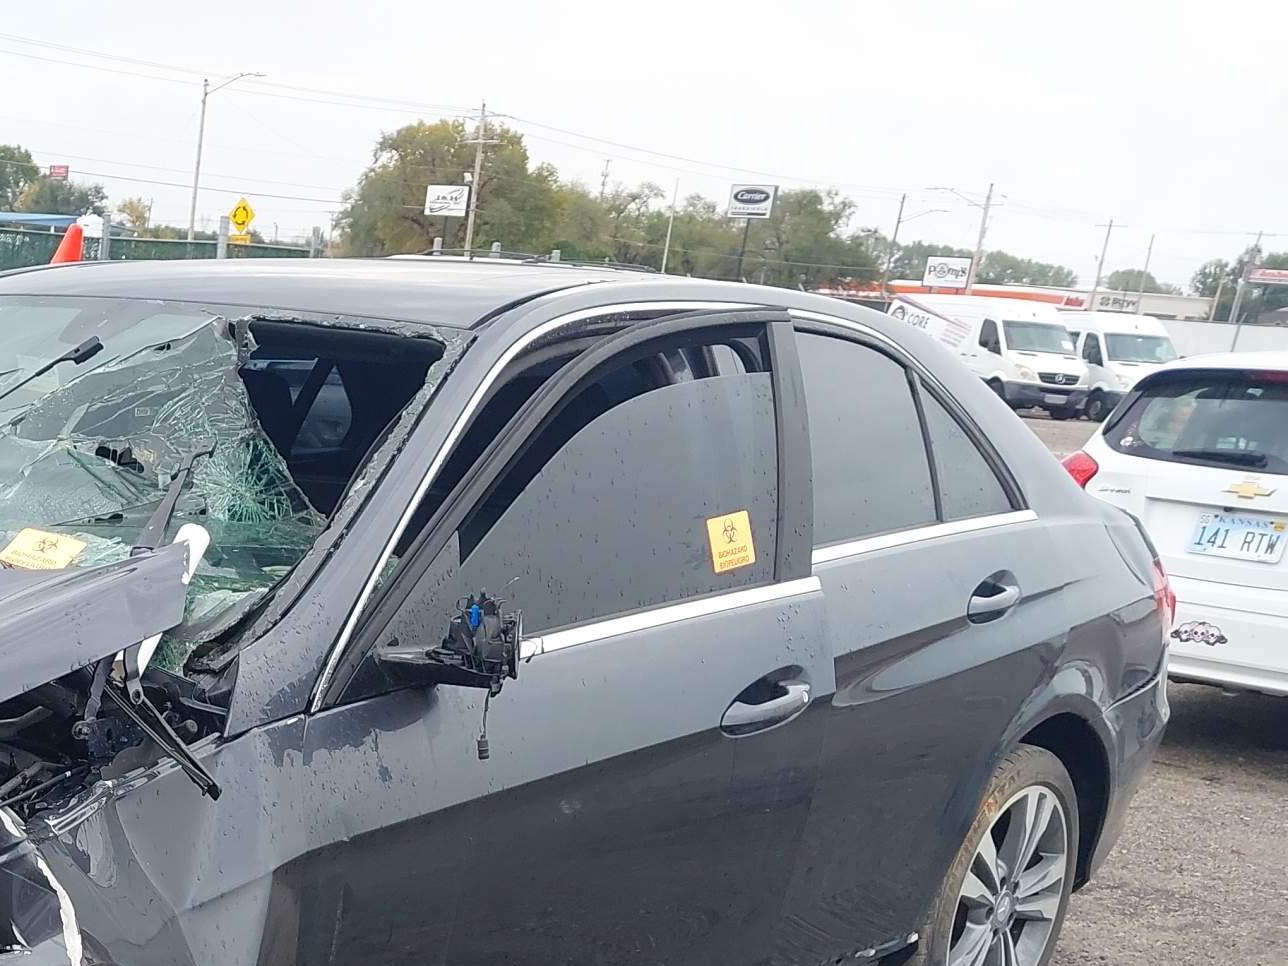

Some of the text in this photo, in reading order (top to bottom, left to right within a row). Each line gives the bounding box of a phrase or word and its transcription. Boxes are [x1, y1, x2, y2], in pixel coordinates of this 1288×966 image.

[737, 191, 767, 200] Carrier
[1219, 515, 1269, 529] KANSAS
[1193, 526, 1280, 555] 141 RTW
